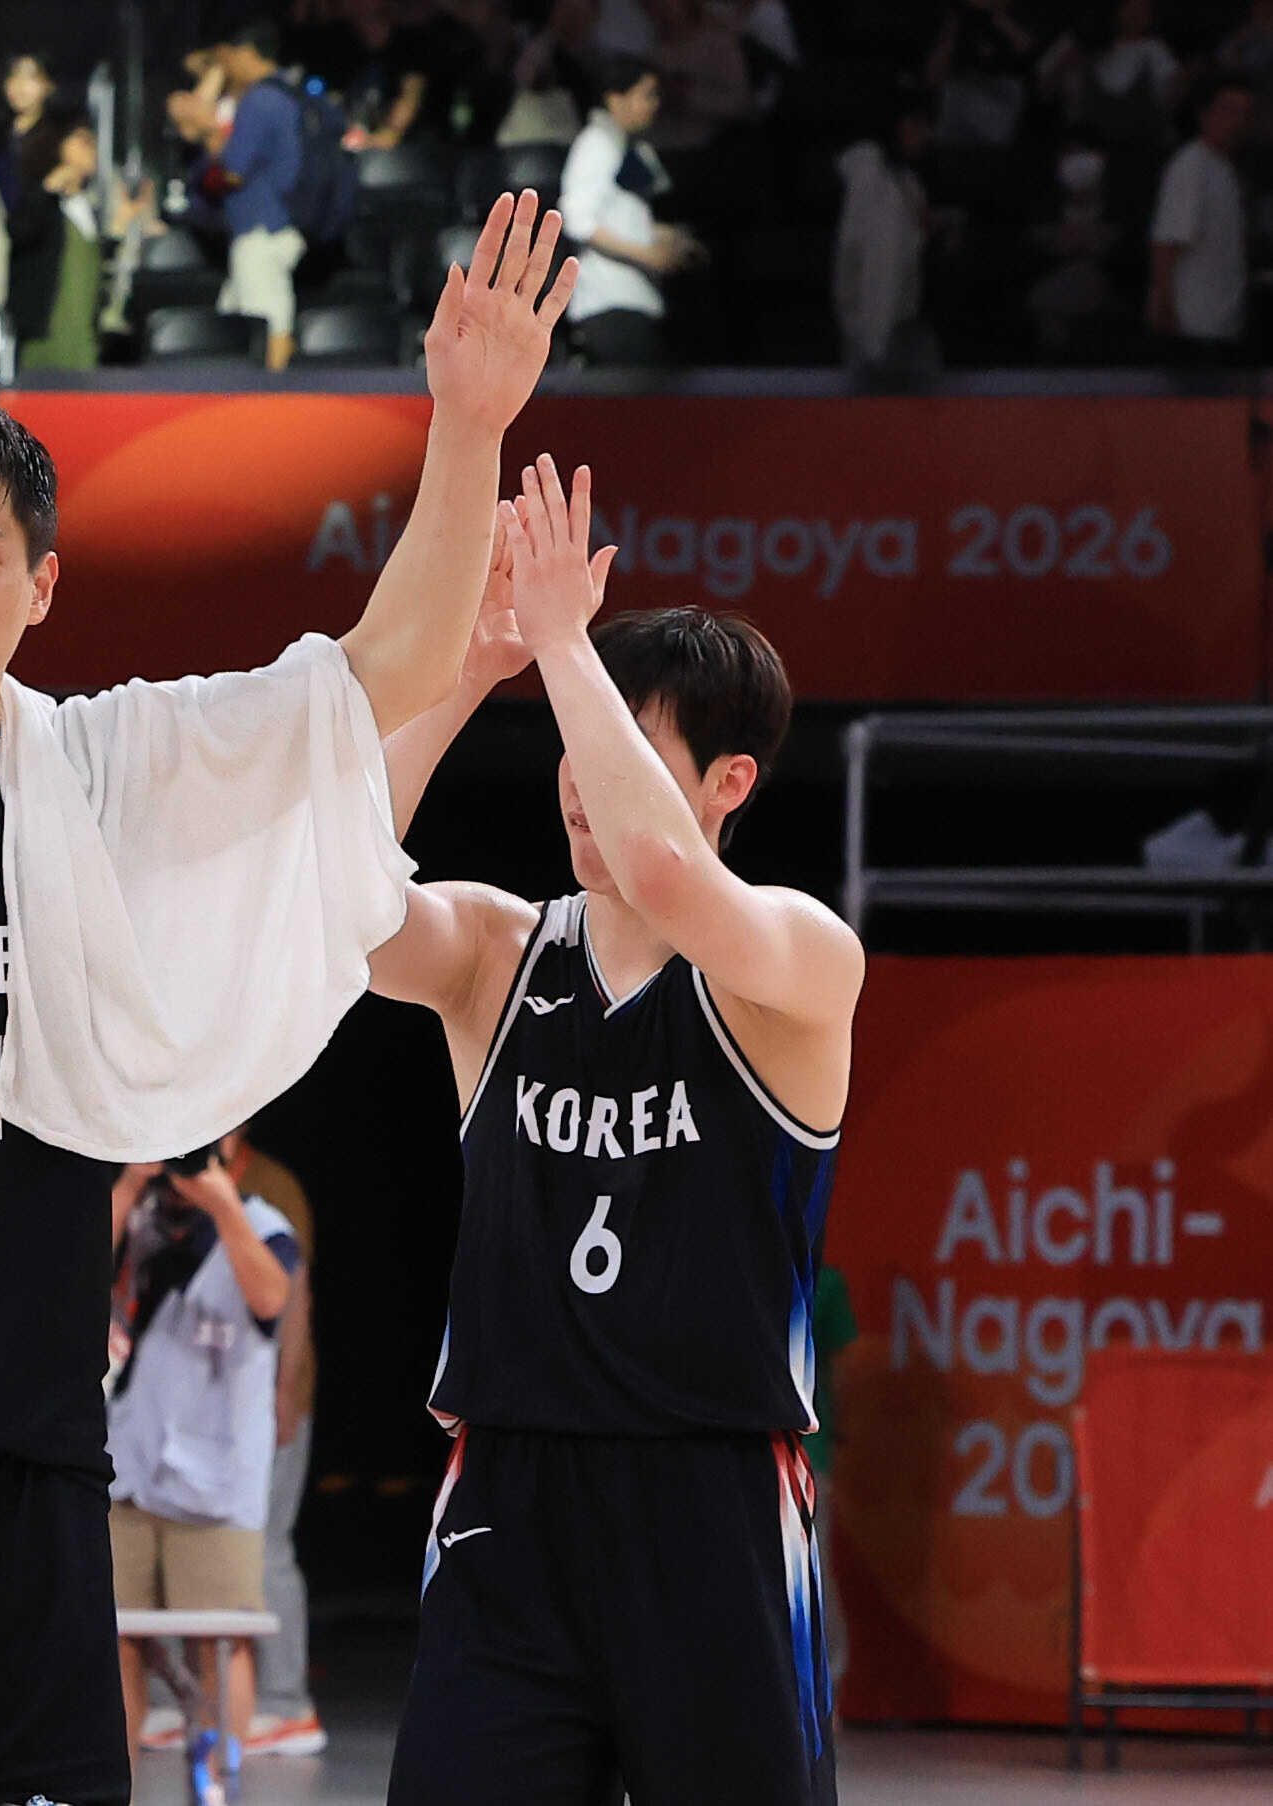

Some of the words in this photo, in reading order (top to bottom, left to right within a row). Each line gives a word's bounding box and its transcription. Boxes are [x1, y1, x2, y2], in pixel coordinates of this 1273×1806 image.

[947, 503, 1173, 578] 2026
[516, 1074, 702, 1160] KOREA
[569, 1194, 623, 1295] 6
[934, 1156, 1225, 1267] Aichi-
